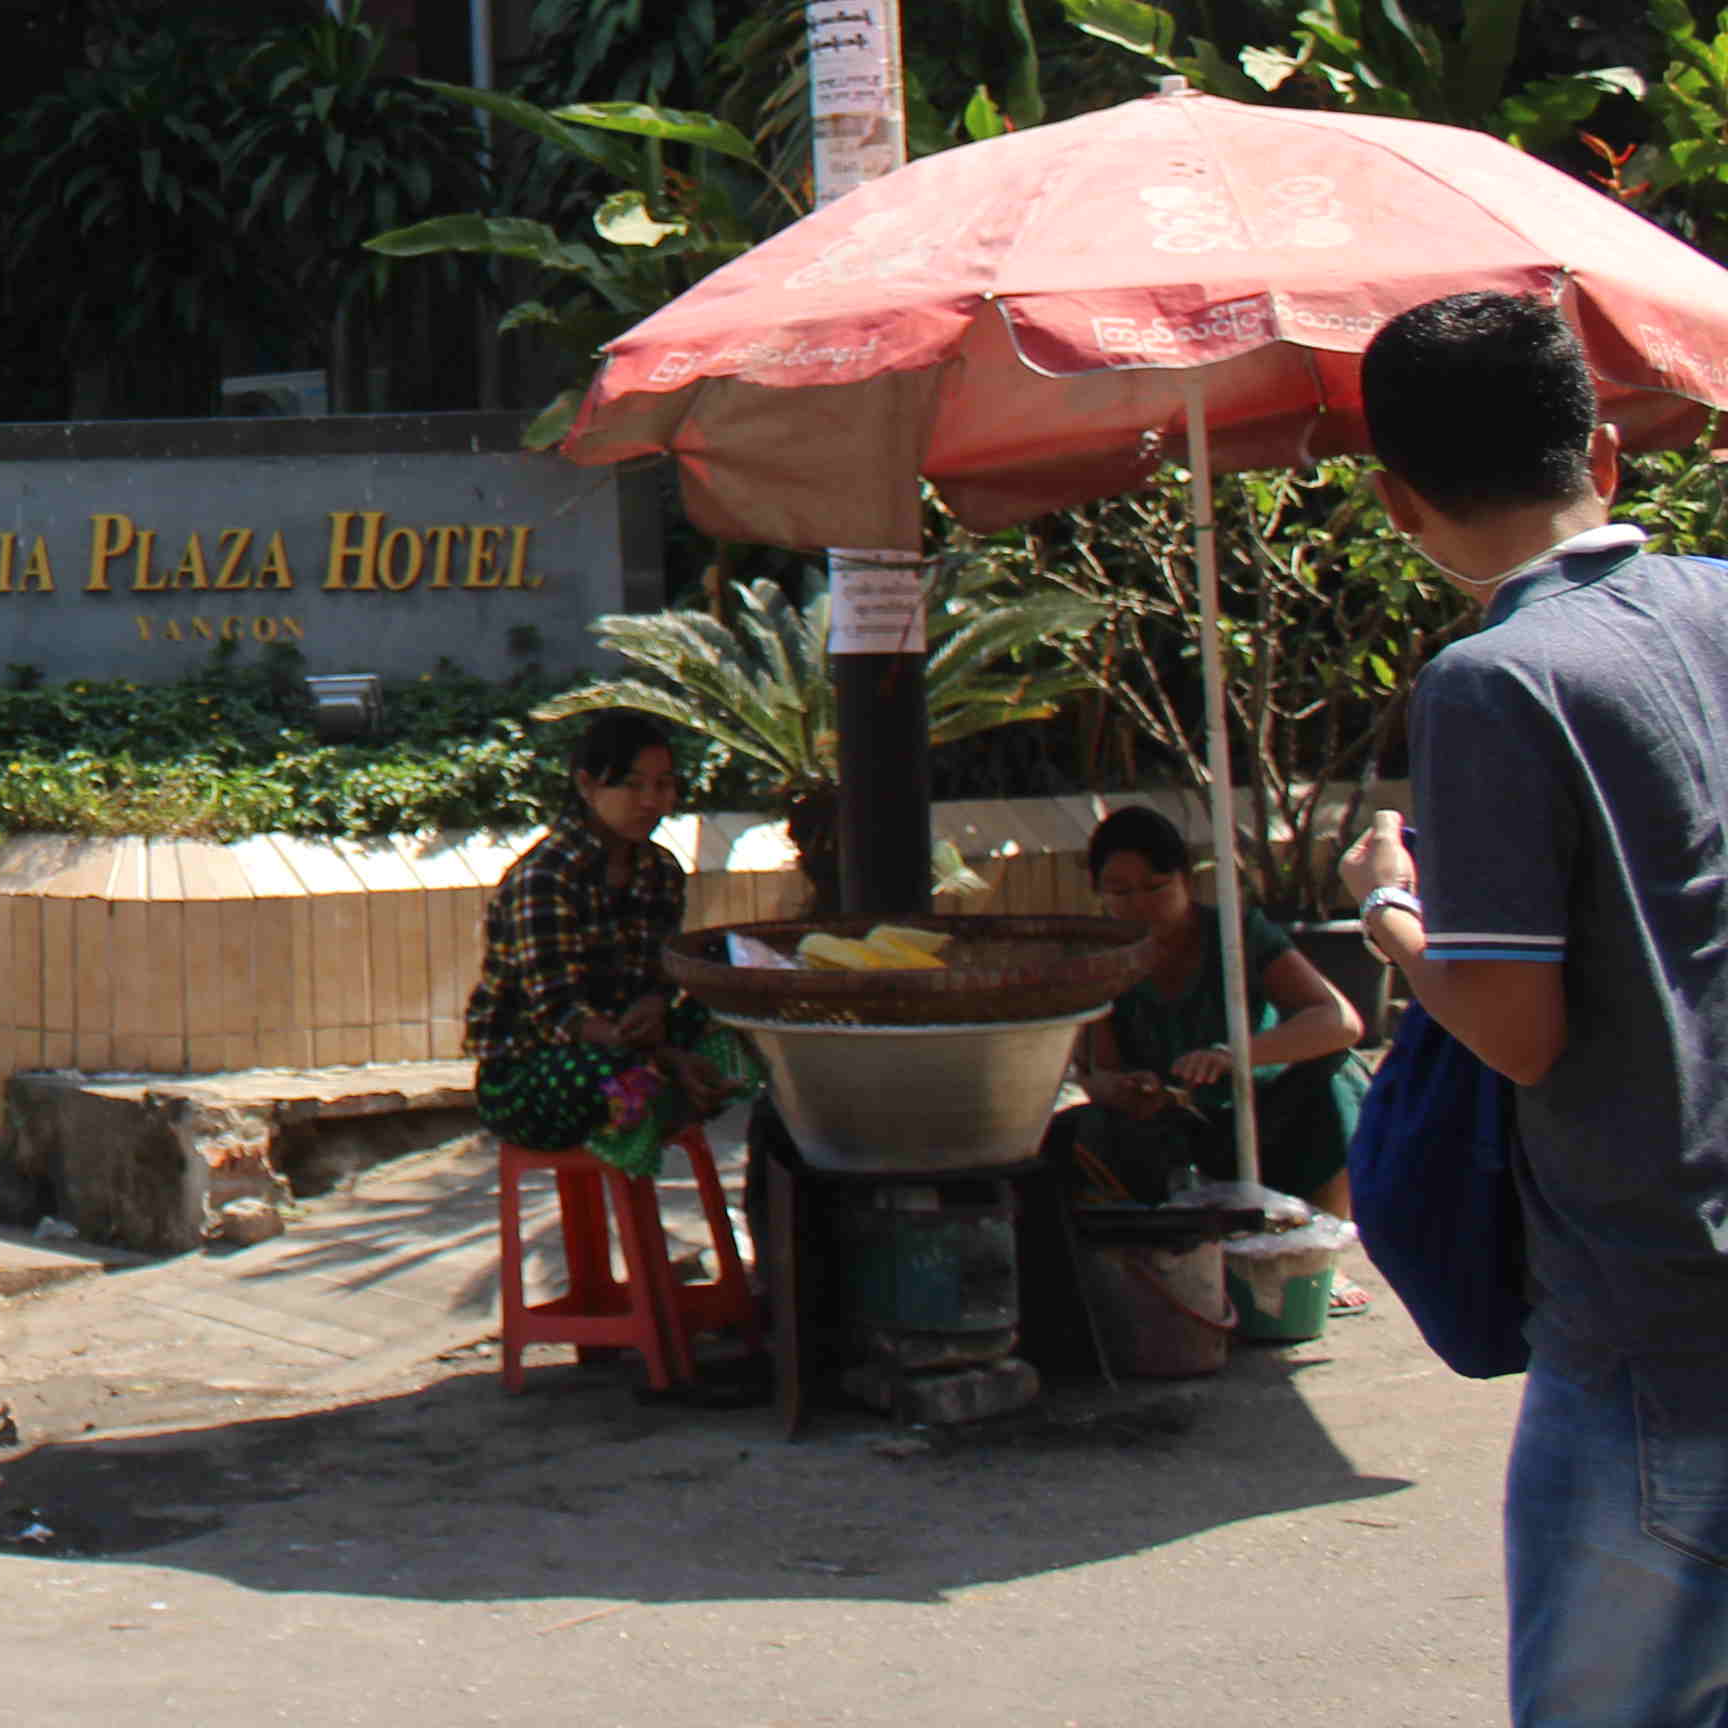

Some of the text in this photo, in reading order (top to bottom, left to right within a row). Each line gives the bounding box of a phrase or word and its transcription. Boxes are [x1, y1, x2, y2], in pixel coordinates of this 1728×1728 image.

[83, 513, 294, 593] PLAZA
[321, 511, 544, 591] HOTEL
[134, 615, 305, 642] YANGON
